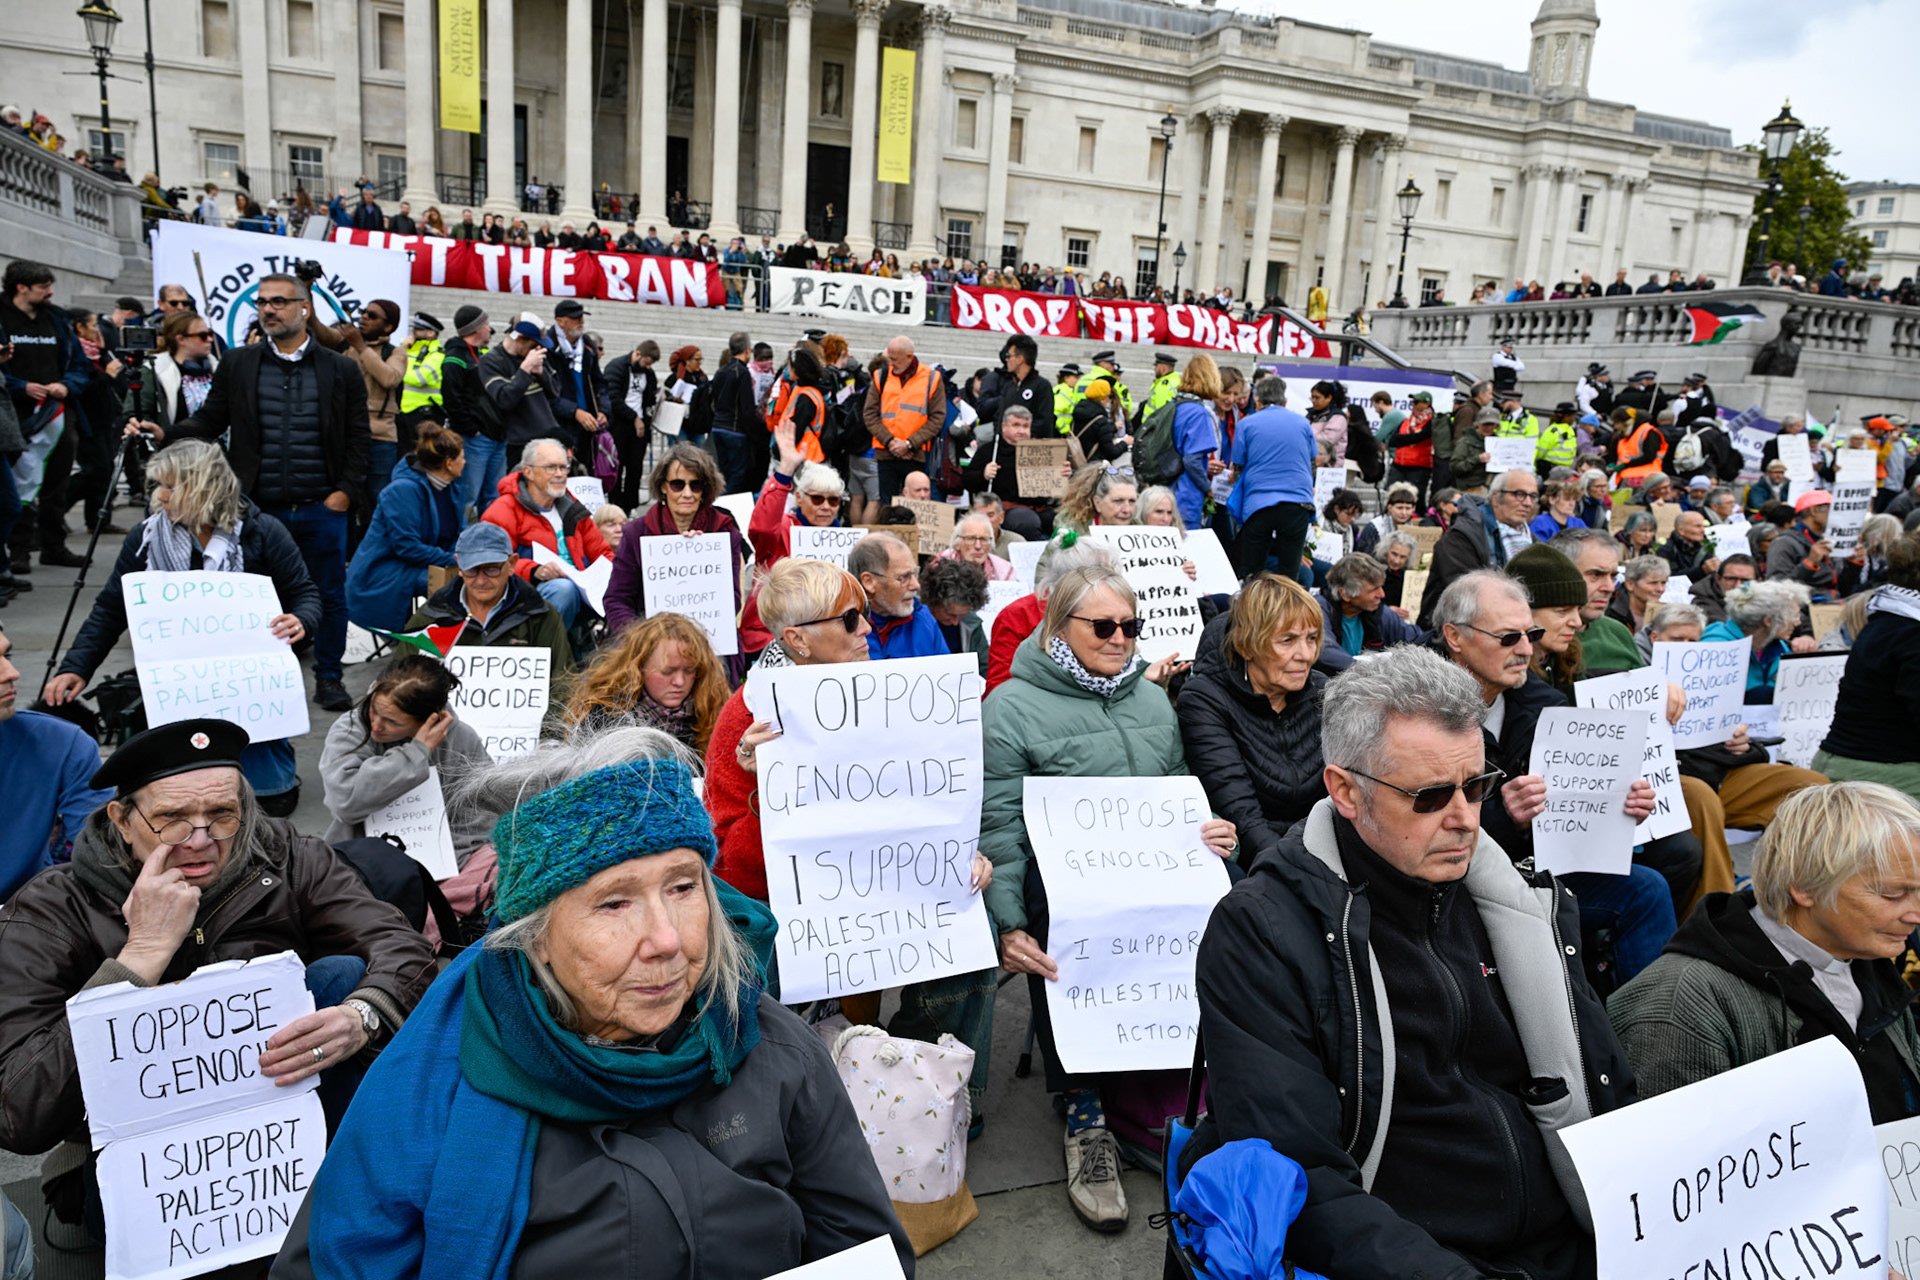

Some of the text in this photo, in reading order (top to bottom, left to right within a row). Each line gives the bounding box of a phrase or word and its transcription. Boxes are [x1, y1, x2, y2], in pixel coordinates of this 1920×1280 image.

[461, 7, 474, 77] GALLERY
[898, 74, 909, 136] GALLERY
[209, 255, 361, 324] STOP TH WA
[475, 242, 578, 296] THE
[598, 254, 709, 308] BAN
[792, 277, 914, 314] PEACE
[953, 284, 1070, 337] DROP
[1079, 297, 1156, 345] THE
[648, 540, 722, 557] I OPPOSE
[798, 530, 861, 548] I OPPOSE
[1117, 533, 1179, 553] OPPOSE
[646, 563, 723, 582] GENOCIDE
[131, 581, 274, 606] I OPPOSE
[653, 590, 717, 608] I SUPPORT
[137, 611, 277, 643] GENOCIDE
[1139, 622, 1195, 641] CTION
[150, 654, 286, 685] I SUPPORT
[449, 655, 548, 680] OPPOSE
[1681, 647, 1741, 673] OPPOSE
[156, 670, 297, 711] PALESTINE
[1681, 670, 1741, 692] GENOCIDE
[772, 671, 979, 736] I OPPOSE
[1609, 684, 1659, 710] OPPOSE
[1548, 721, 1627, 740] I OPPOSE
[1544, 749, 1621, 769] GENOCIDE
[765, 757, 968, 816] GENOCIDE
[1552, 774, 1617, 792] SUPPORT
[385, 807, 434, 821] SUPPORT
[1043, 796, 1199, 837] I OPPOSE
[1544, 800, 1609, 815] ALESTINE
[1535, 818, 1589, 833] ACTION
[788, 836, 980, 905] I SUPPORT
[1064, 849, 1204, 878] GENOCIDE
[787, 900, 957, 956] PALESTINE
[1073, 930, 1201, 960] I SUPPOR
[825, 937, 954, 995] ACTION
[106, 987, 278, 1062] I OPPOSE
[139, 1041, 269, 1100] GENOC
[141, 1118, 301, 1188] I SUPPORT
[155, 1158, 308, 1224] PALESTINE
[1630, 1192, 1645, 1242] I
[1672, 1121, 1810, 1223] OPPOSE
[169, 1202, 290, 1268] ACTION
